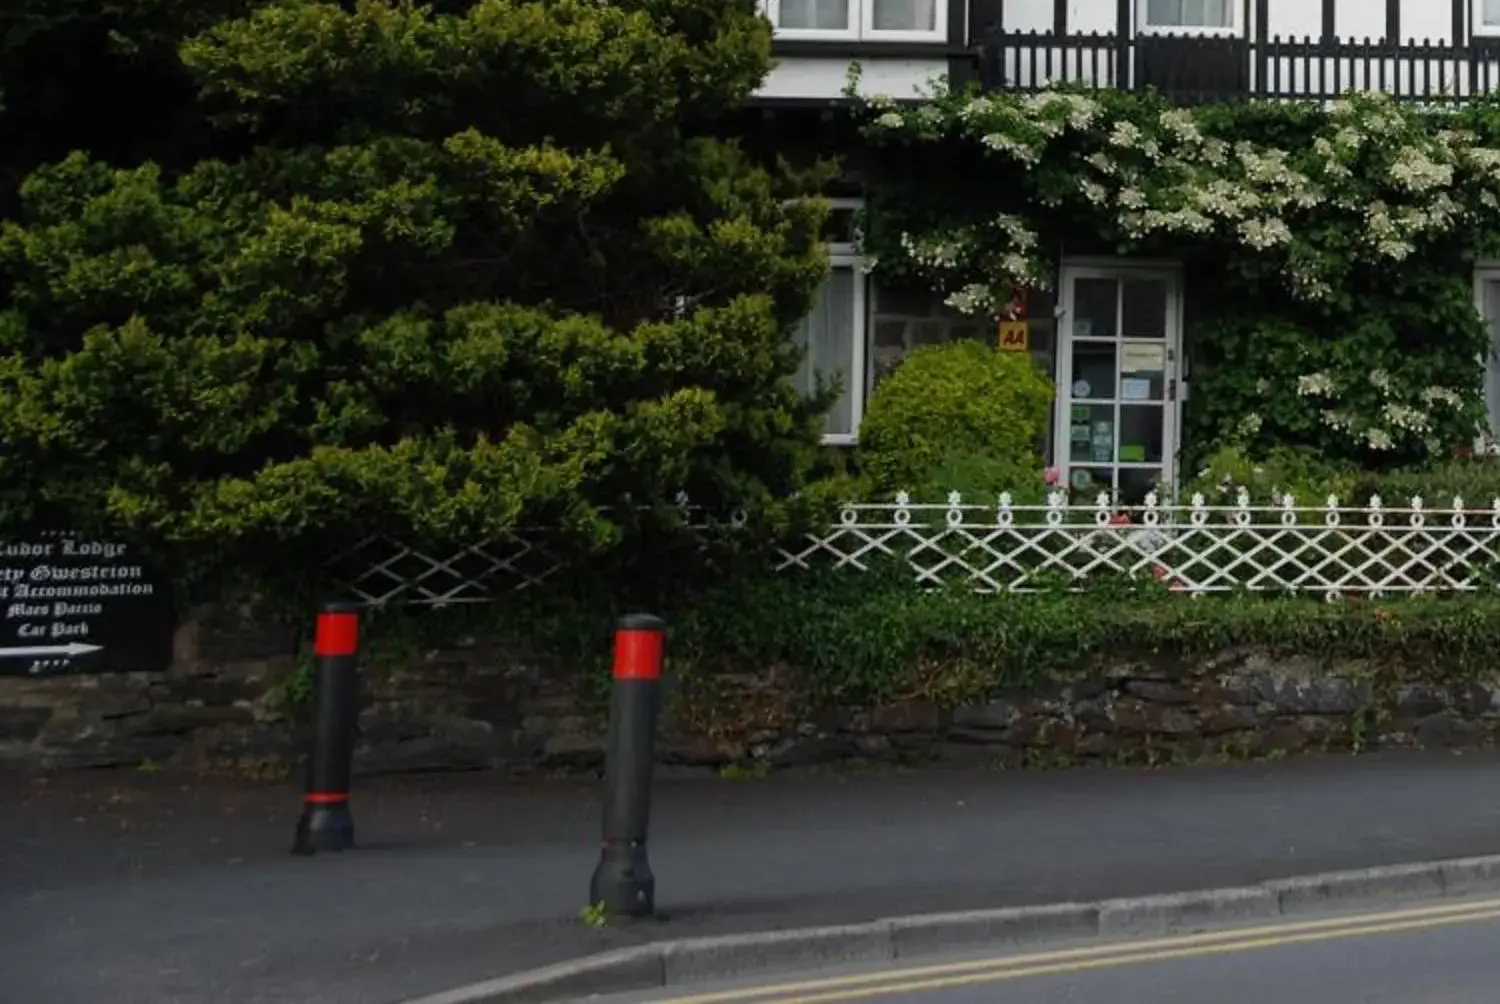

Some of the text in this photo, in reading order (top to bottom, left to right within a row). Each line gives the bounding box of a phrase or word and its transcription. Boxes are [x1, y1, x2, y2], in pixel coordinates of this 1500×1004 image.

[1004, 329, 1025, 345] AA
[61, 539, 127, 558] Lodge
[14, 583, 153, 598] Accommodation
[17, 621, 89, 638] Car Park
